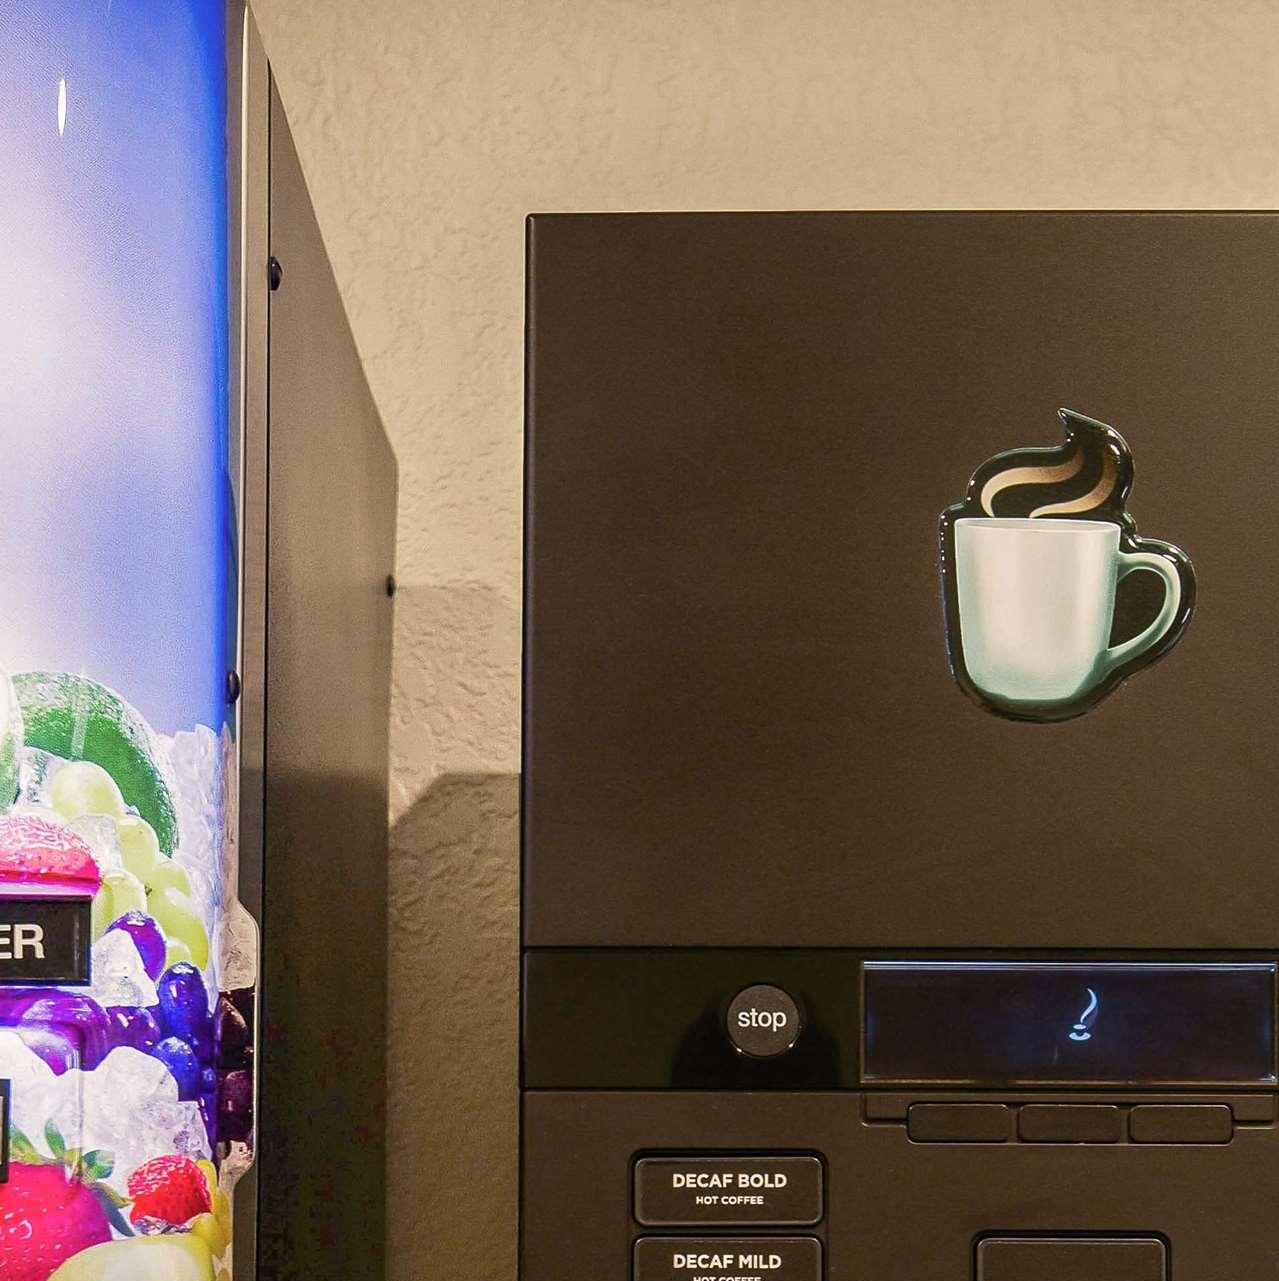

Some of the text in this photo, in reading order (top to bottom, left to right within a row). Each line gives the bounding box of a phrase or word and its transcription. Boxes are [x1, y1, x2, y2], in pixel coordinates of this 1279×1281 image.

[737, 1007, 787, 1032] stop
[672, 1173, 788, 1188] DECAF BOLD
[695, 1195, 764, 1205] HOT COFFEE
[673, 1254, 782, 1269] DECAF MILD
